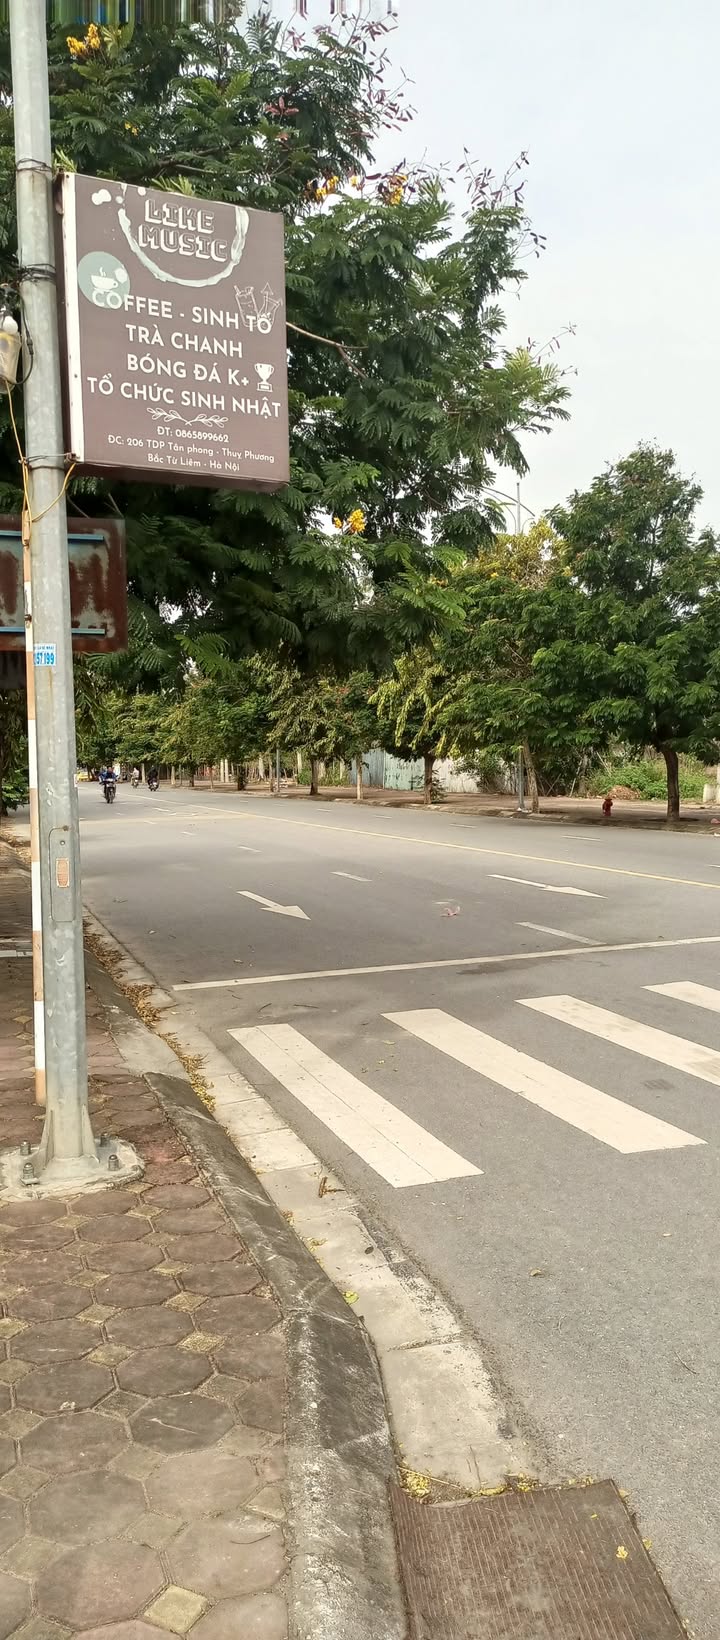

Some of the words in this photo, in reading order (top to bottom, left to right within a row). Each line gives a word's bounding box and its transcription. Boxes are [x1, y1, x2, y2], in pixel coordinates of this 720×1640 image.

[145, 199, 214, 234] LIKE
[138, 224, 228, 262] MUSIC
[92, 290, 173, 318] COFFEE
[191, 306, 239, 330] SINH
[246, 314, 272, 334] TỐ
[125, 323, 165, 347] TRÀ
[170, 332, 243, 358] CHANH
[127, 353, 187, 378] BÓNG
[193, 363, 221, 384] ĐÁ
[228, 368, 249, 386] K+
[87, 373, 114, 395] TỔ
[120, 383, 175, 404] CHỨC
[181, 391, 225, 411] SINH
[232, 397, 281, 419] NHẬT
[107, 434, 125, 445] ĐC:
[126, 438, 144, 447] 206
[147, 439, 165, 449] TDP
[168, 442, 184, 452] Tân
[187, 444, 214, 456] phong
[244, 450, 275, 463] Phương
[157, 426, 173, 436] ĐT:
[175, 429, 229, 443] 0865899662
[148, 453, 164, 463] Bắc
[180, 457, 201, 467] Liêm
[224, 462, 240, 472] Nội
